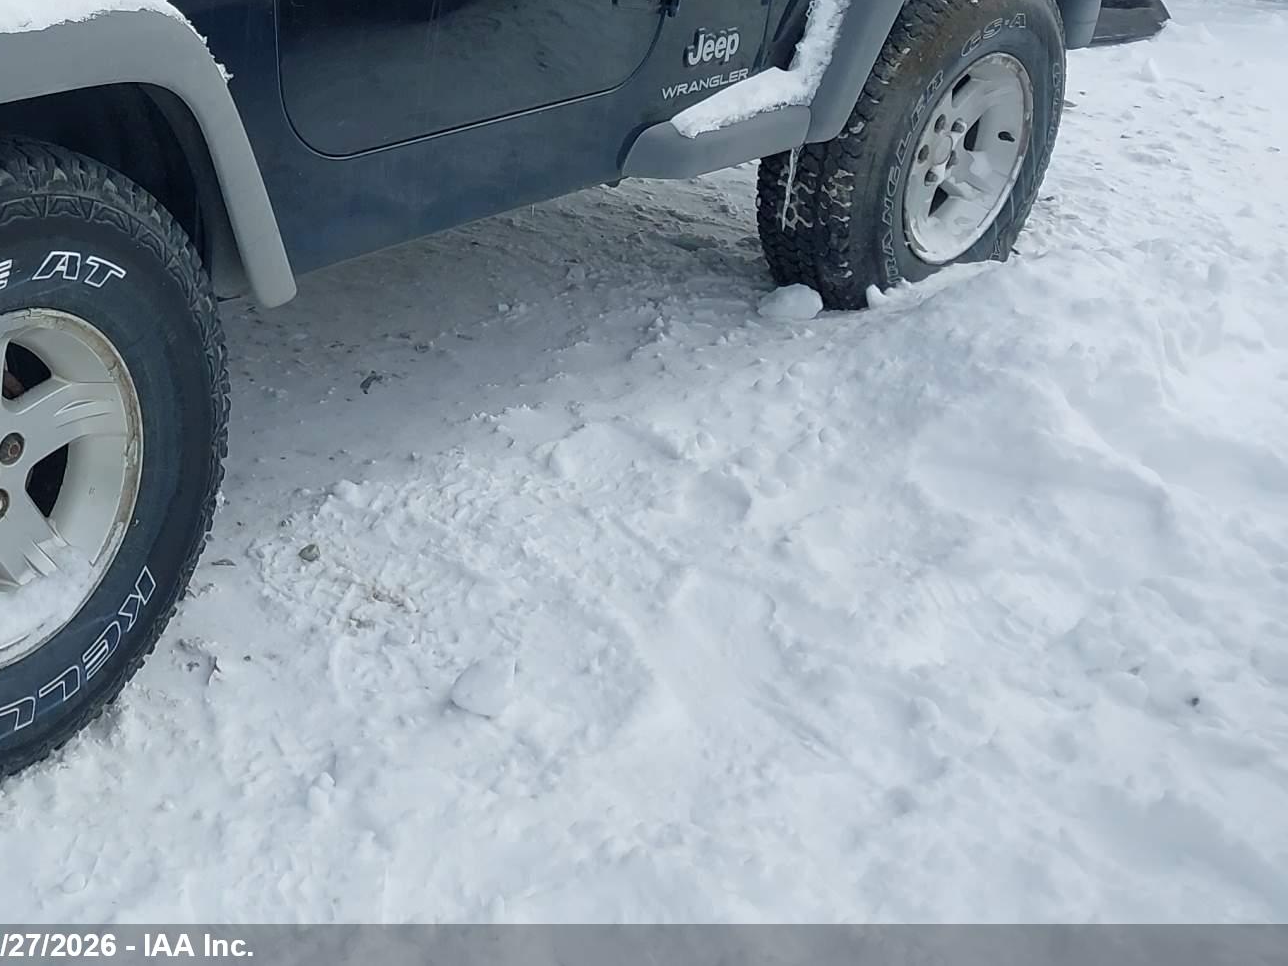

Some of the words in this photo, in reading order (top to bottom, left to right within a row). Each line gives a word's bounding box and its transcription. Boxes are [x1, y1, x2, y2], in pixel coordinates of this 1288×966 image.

[687, 32, 740, 66] Jeep
[661, 67, 749, 101] WRANGLER
[31, 250, 127, 289] AT
